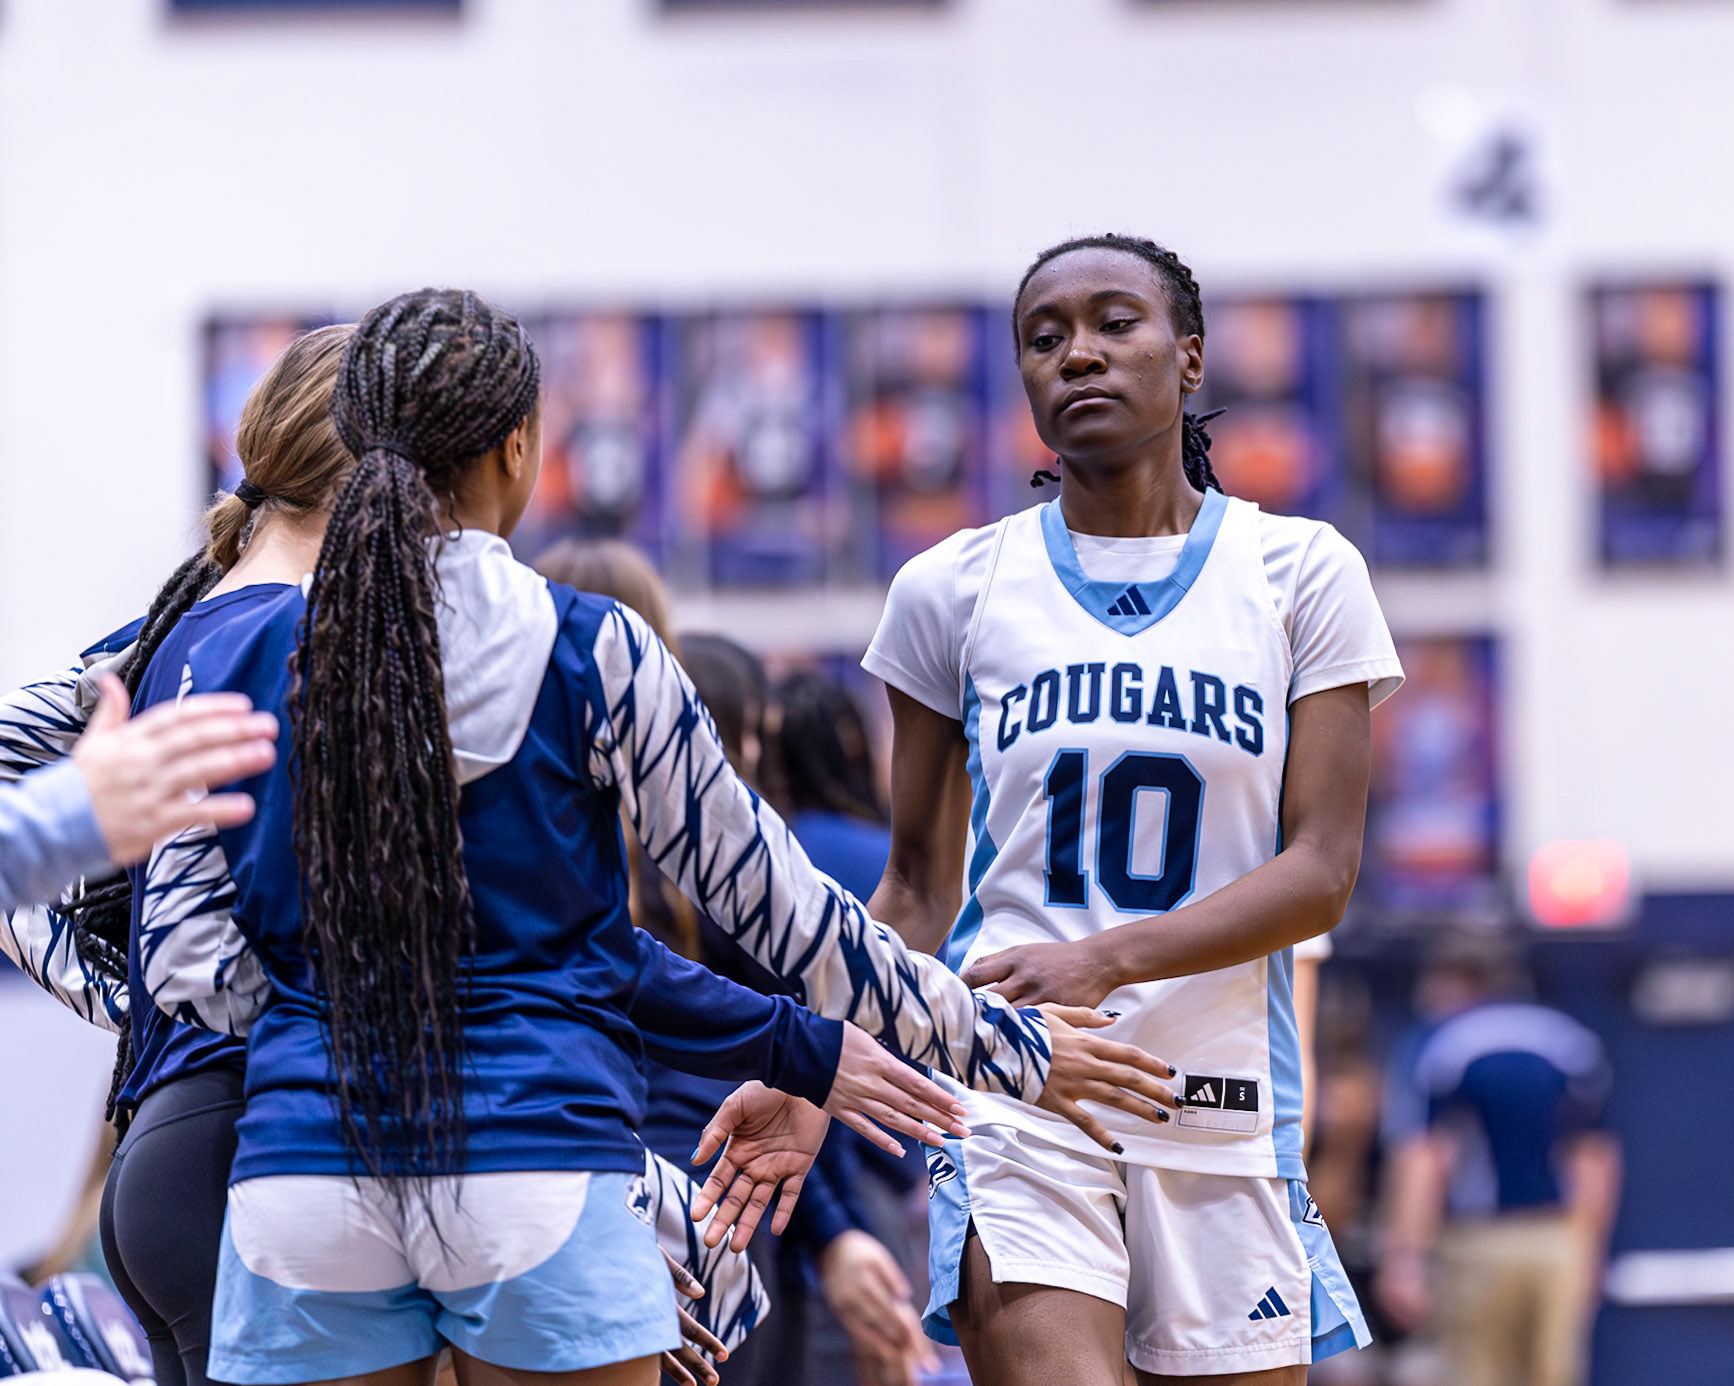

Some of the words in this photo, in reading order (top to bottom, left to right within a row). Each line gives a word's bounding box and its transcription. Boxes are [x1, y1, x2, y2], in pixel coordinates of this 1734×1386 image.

[997, 662, 1264, 757] COUGARS
[1043, 748, 1206, 914] 10
[1239, 1091, 1246, 1101] S
